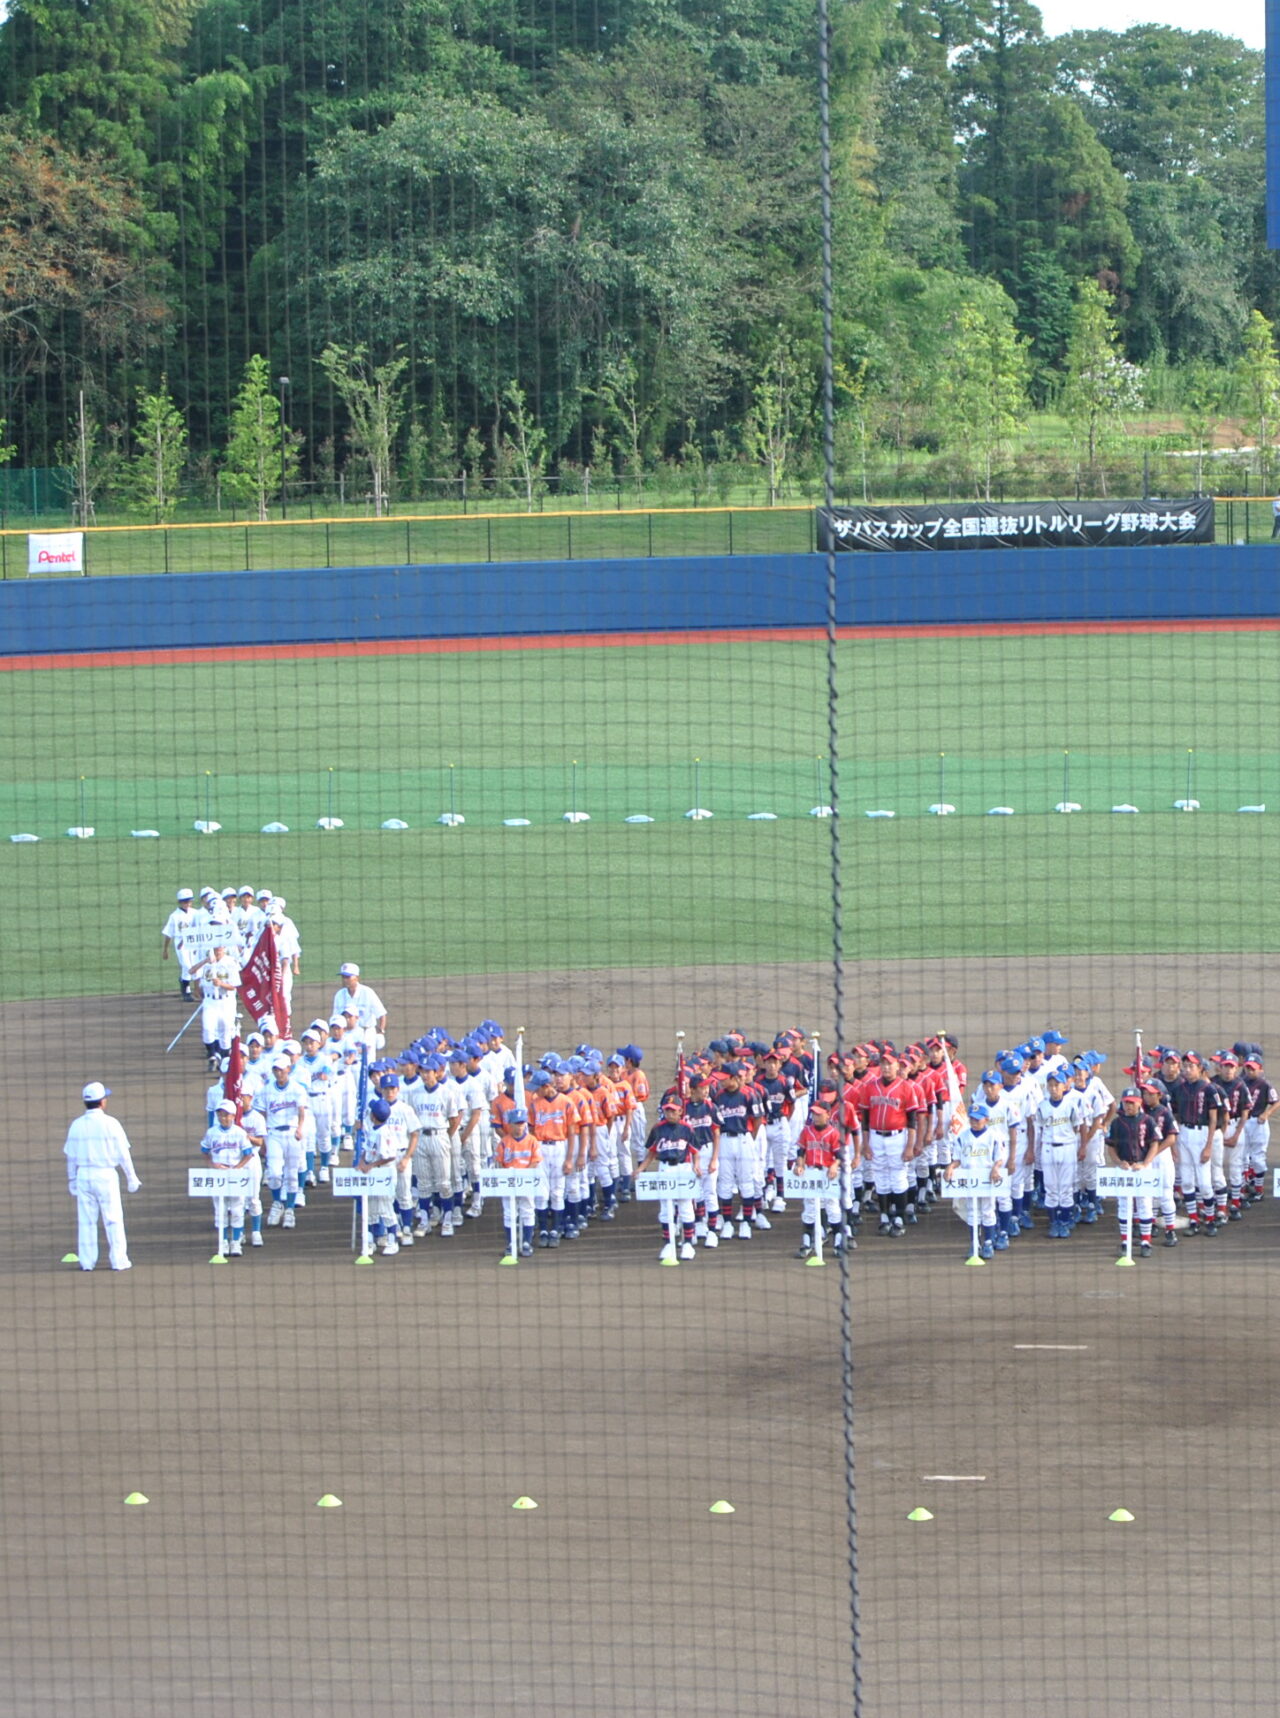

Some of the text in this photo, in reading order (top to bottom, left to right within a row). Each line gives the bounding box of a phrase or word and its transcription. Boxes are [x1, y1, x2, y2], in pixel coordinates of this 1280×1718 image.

[834, 512, 1197, 539] ザバスカップ全国選抜リトルリーグ野球大会
[38, 550, 76, 563] Pentel
[187, 931, 233, 943] 市川リーグ
[193, 1177, 249, 1188] 望月リーグ
[639, 1179, 696, 1191] 千葉市リーグ
